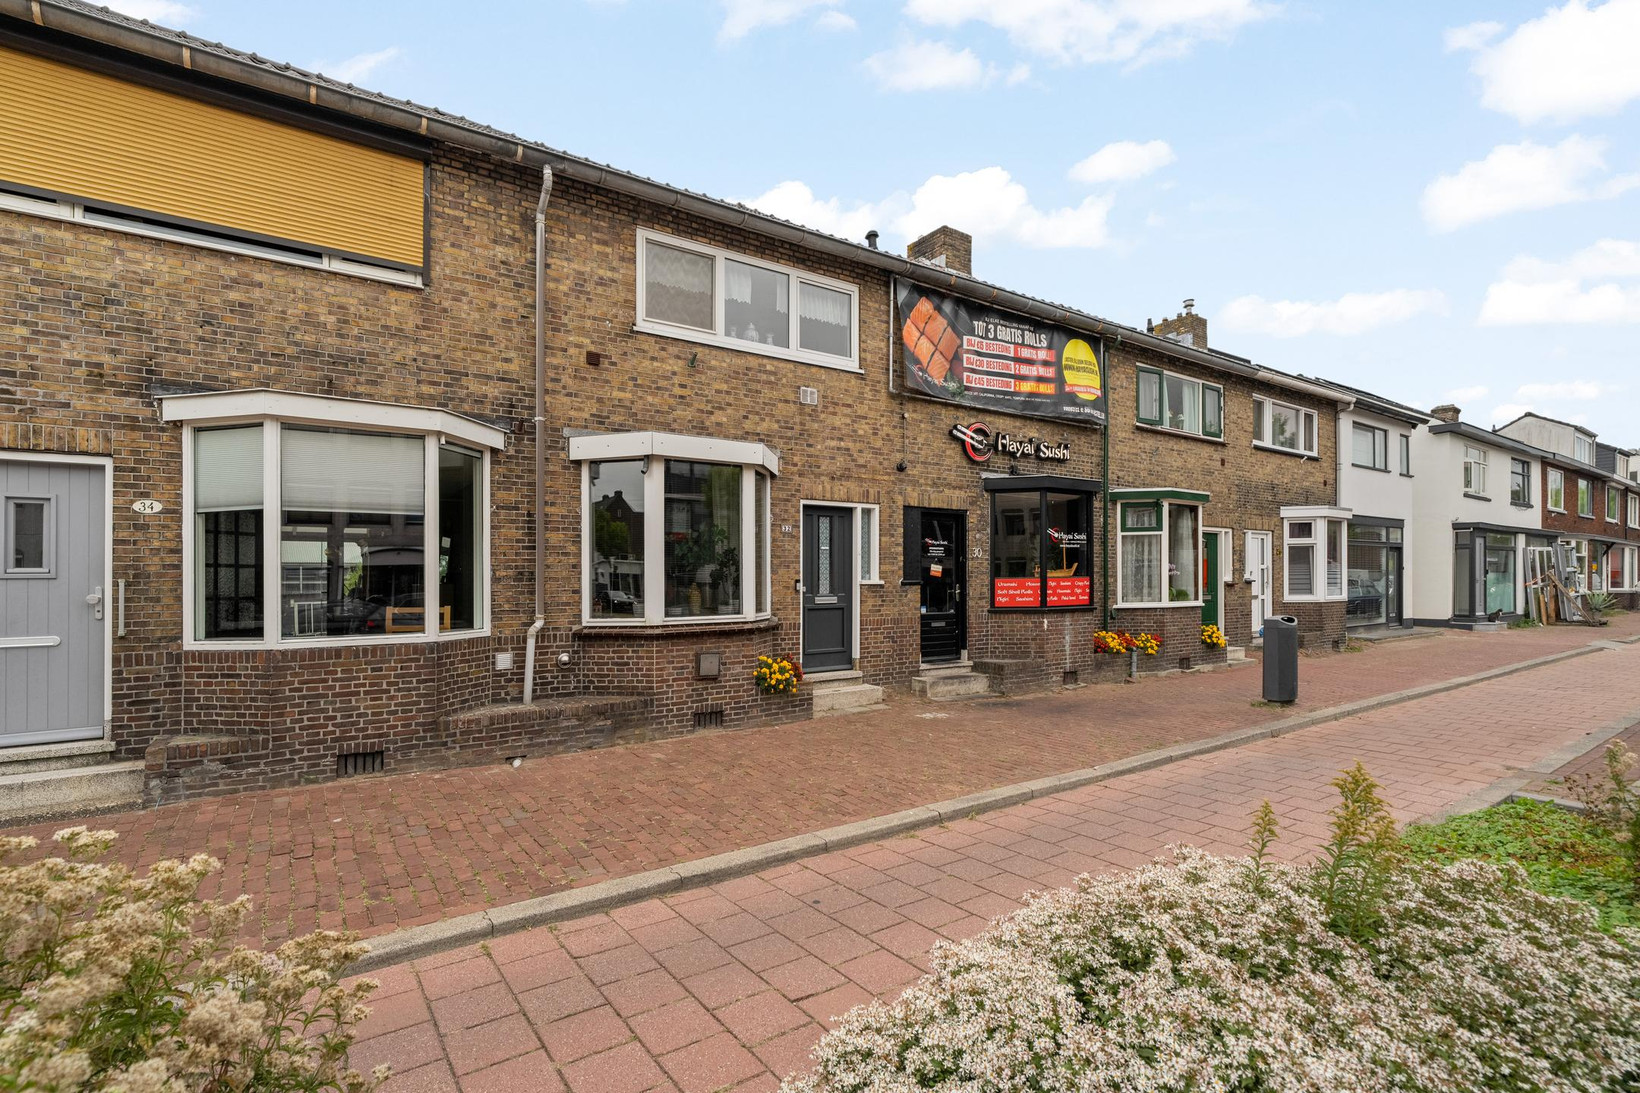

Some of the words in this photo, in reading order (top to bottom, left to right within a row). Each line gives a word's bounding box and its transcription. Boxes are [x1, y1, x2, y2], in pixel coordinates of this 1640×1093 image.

[973, 321, 986, 338] TOT
[988, 324, 994, 339] 3
[997, 325, 1022, 344] GRATIS
[1025, 331, 1047, 347] ROLLS
[966, 338, 975, 348] BIJ
[985, 341, 1012, 354] BESTEDING
[1021, 348, 1036, 359] GRATIS
[965, 356, 975, 367] BIJ
[975, 357, 984, 368] €30
[986, 359, 1012, 372] BESTEDING
[1015, 364, 1020, 374] 2
[1020, 365, 1037, 375] GRATIS
[965, 375, 974, 384] BIJ
[974, 376, 984, 386] €45
[986, 377, 1012, 389] BESTEDING
[1015, 381, 1020, 390] 3
[997, 433, 1035, 457] Hayai
[1039, 442, 1070, 460] Sushi
[138, 501, 154, 511] 34
[972, 547, 983, 557] 30
